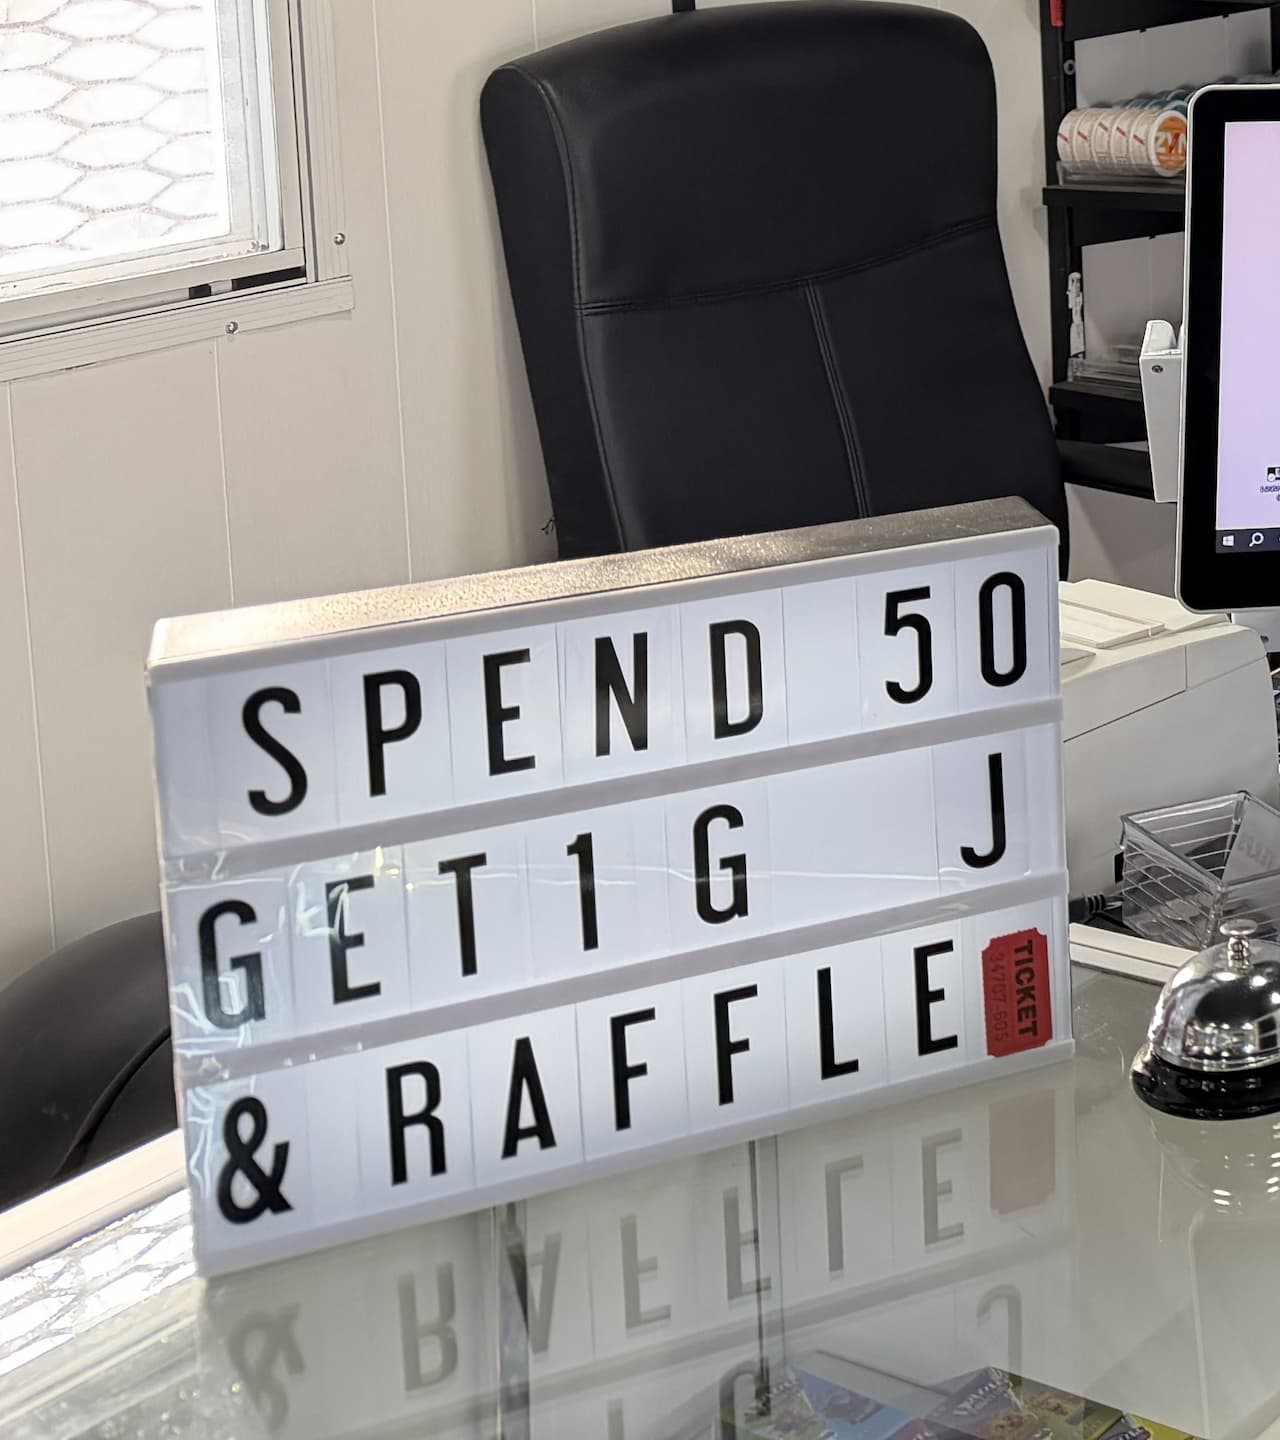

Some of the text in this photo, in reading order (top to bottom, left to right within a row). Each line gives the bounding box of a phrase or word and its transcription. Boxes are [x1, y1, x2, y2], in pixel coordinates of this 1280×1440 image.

[242, 572, 1028, 816] SPEND 50
[961, 752, 1007, 869] J
[1015, 940, 1038, 1037] TICKET
[217, 938, 959, 1225] & RAFFLE
